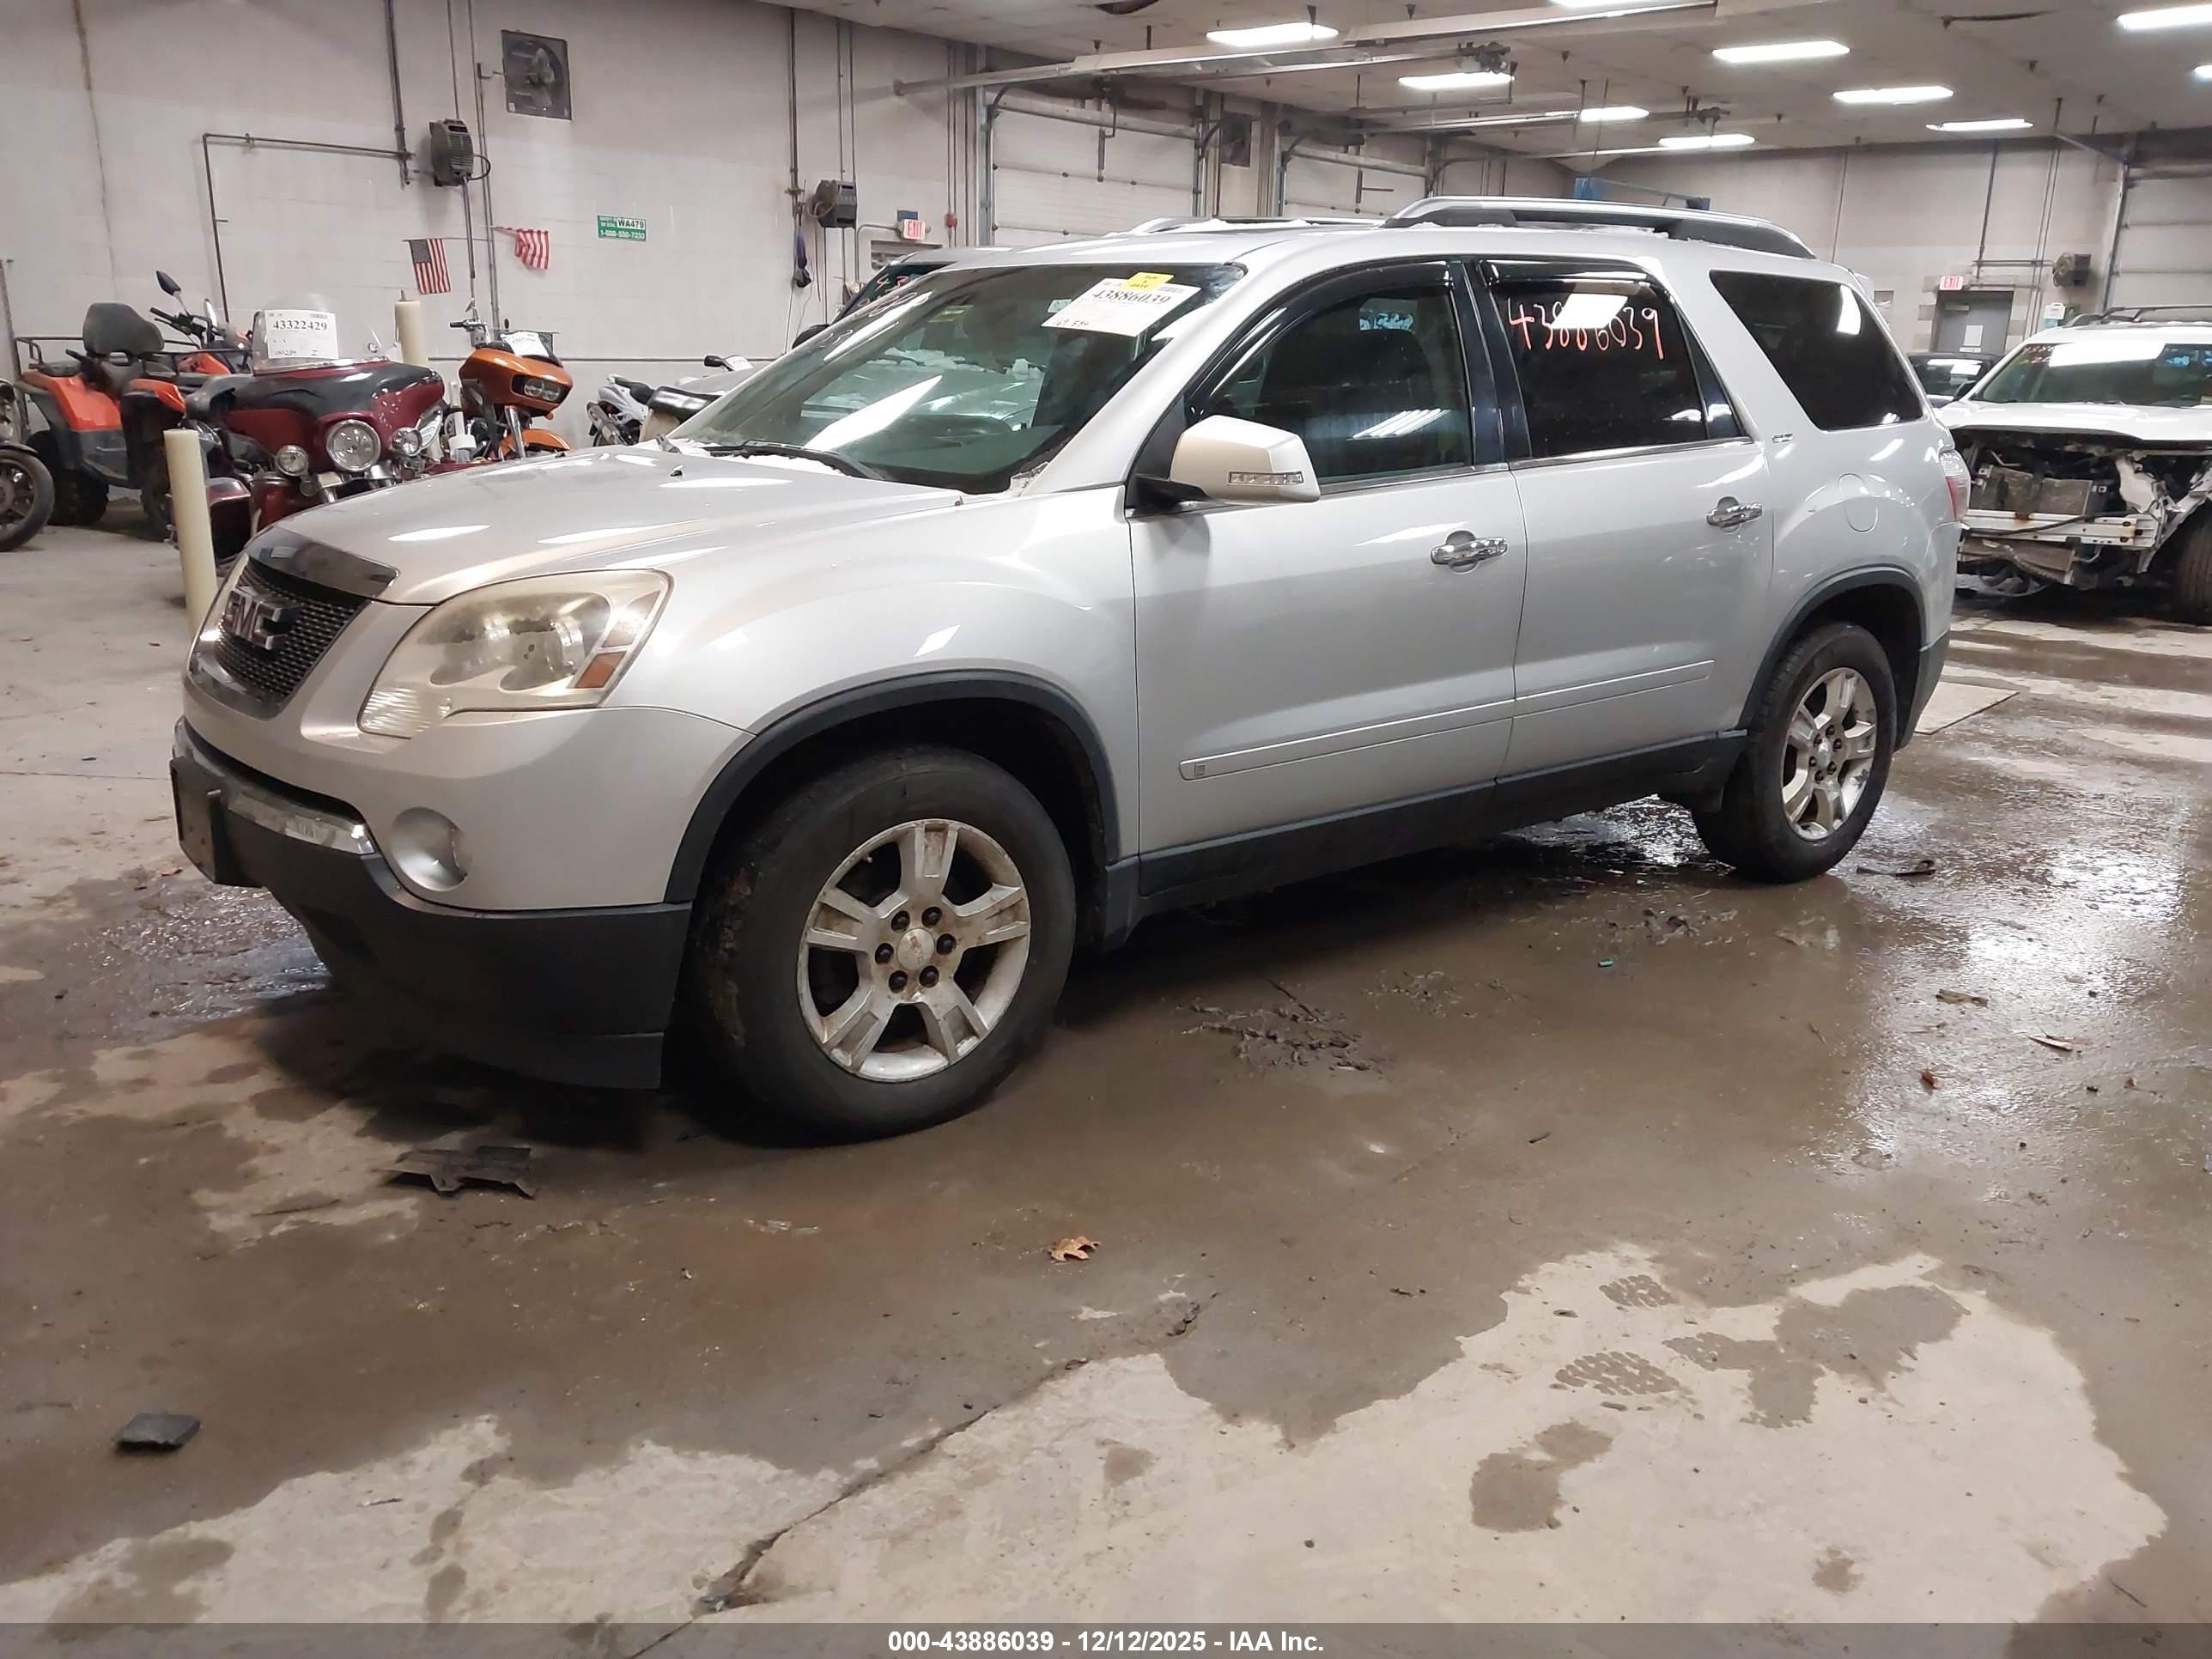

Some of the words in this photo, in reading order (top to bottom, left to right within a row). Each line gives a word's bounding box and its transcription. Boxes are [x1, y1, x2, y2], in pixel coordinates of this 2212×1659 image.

[618, 219, 644, 228] WA479
[1092, 289, 1171, 304] 43886039
[273, 320, 328, 331] 43322429
